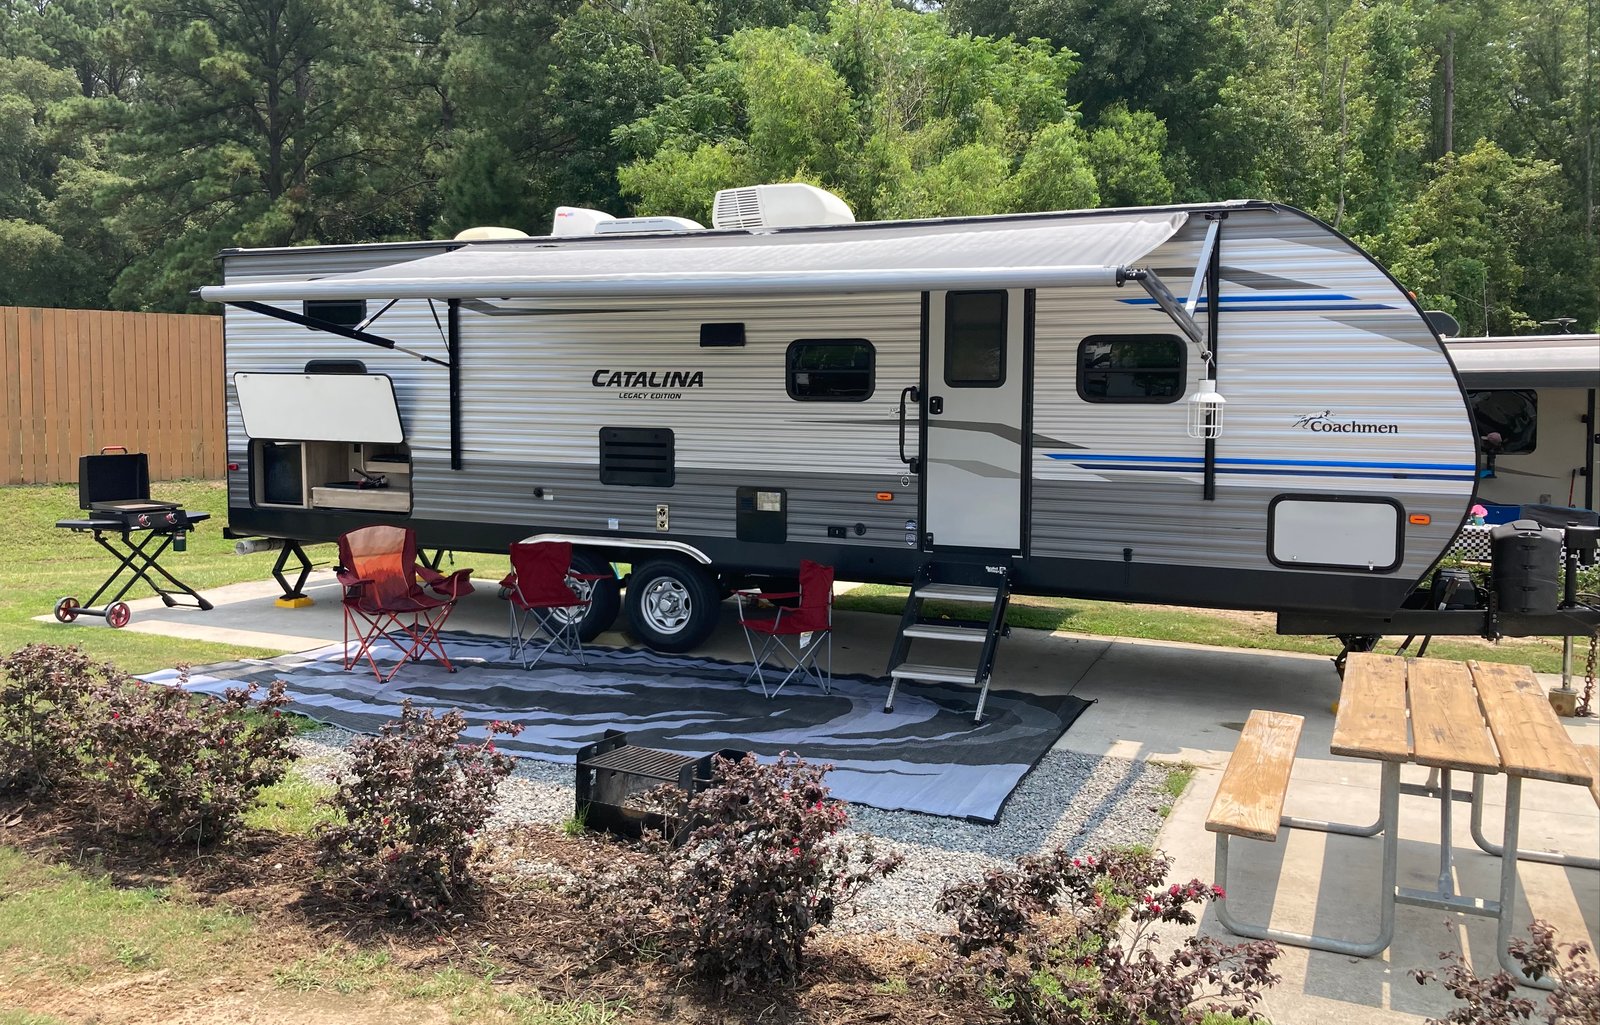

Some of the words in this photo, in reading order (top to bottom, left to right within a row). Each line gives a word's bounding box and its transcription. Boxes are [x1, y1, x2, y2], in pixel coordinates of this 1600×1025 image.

[591, 369, 704, 388] CATALINA
[650, 392, 682, 400] EDITION
[1310, 420, 1399, 434] Coachmen
